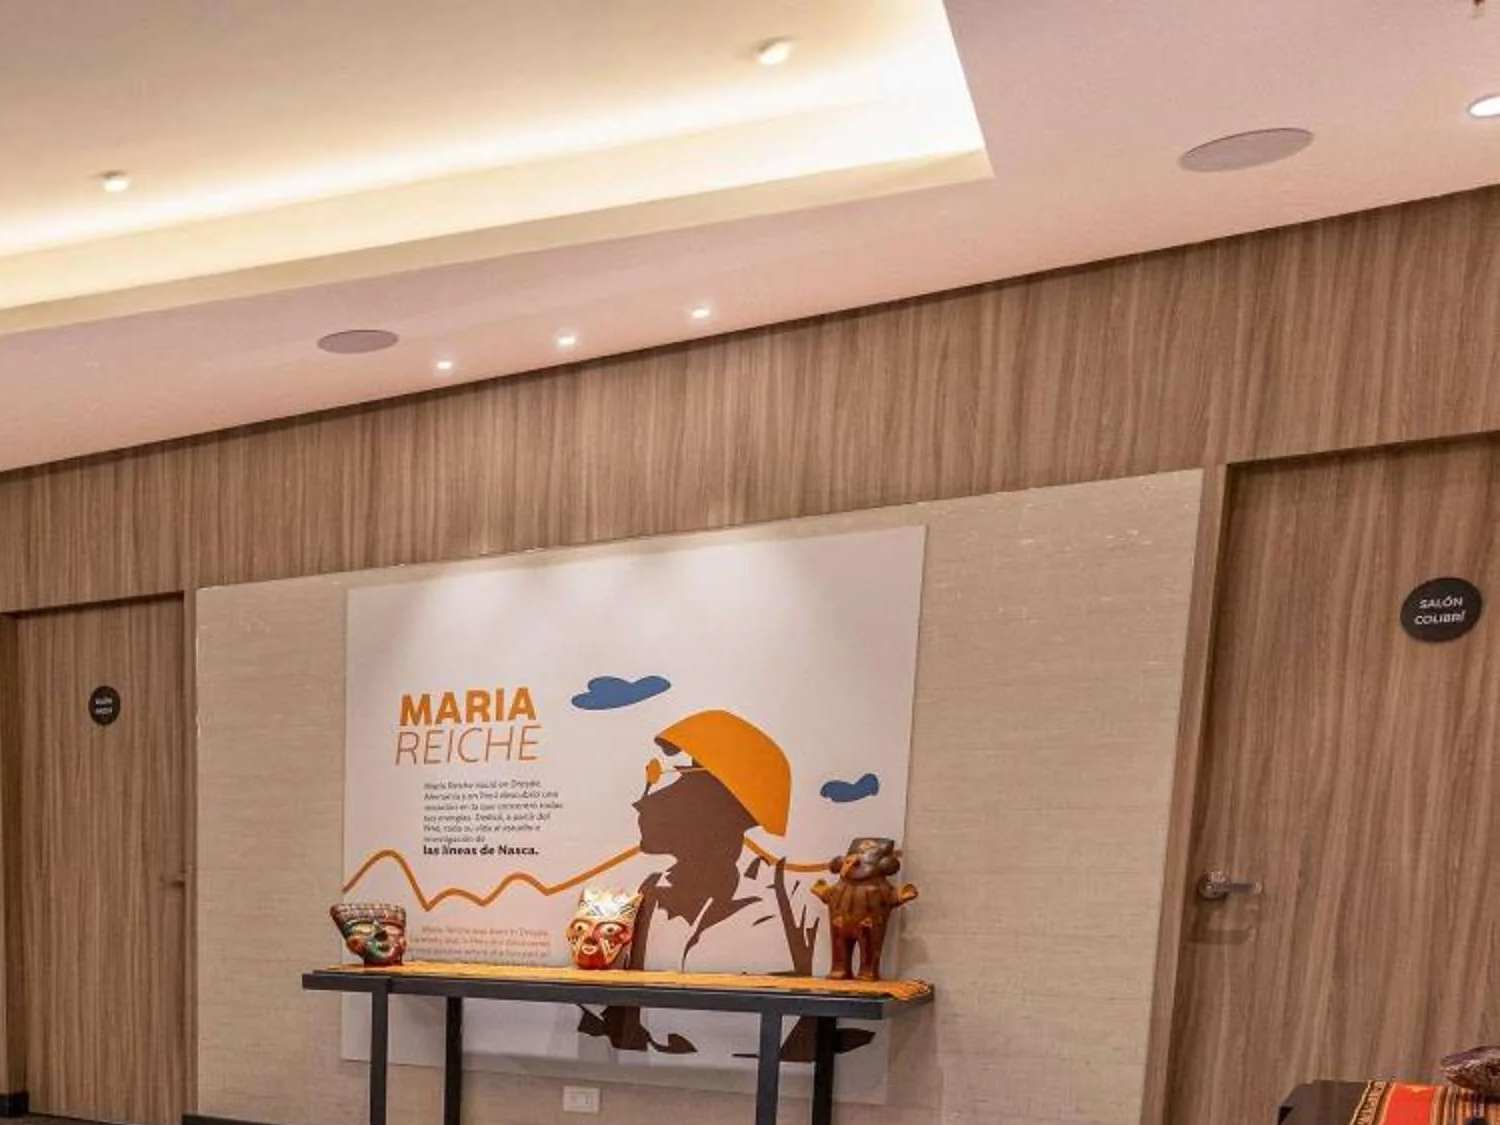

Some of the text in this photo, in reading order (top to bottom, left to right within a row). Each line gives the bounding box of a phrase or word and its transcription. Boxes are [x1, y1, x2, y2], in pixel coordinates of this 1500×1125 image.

[1419, 595, 1464, 609] SALÓN
[1413, 610, 1467, 625] COLIBRÍ
[400, 687, 537, 726] MARIA
[396, 725, 542, 765] REICHE
[423, 844, 539, 855] las líneas de Nasca.
